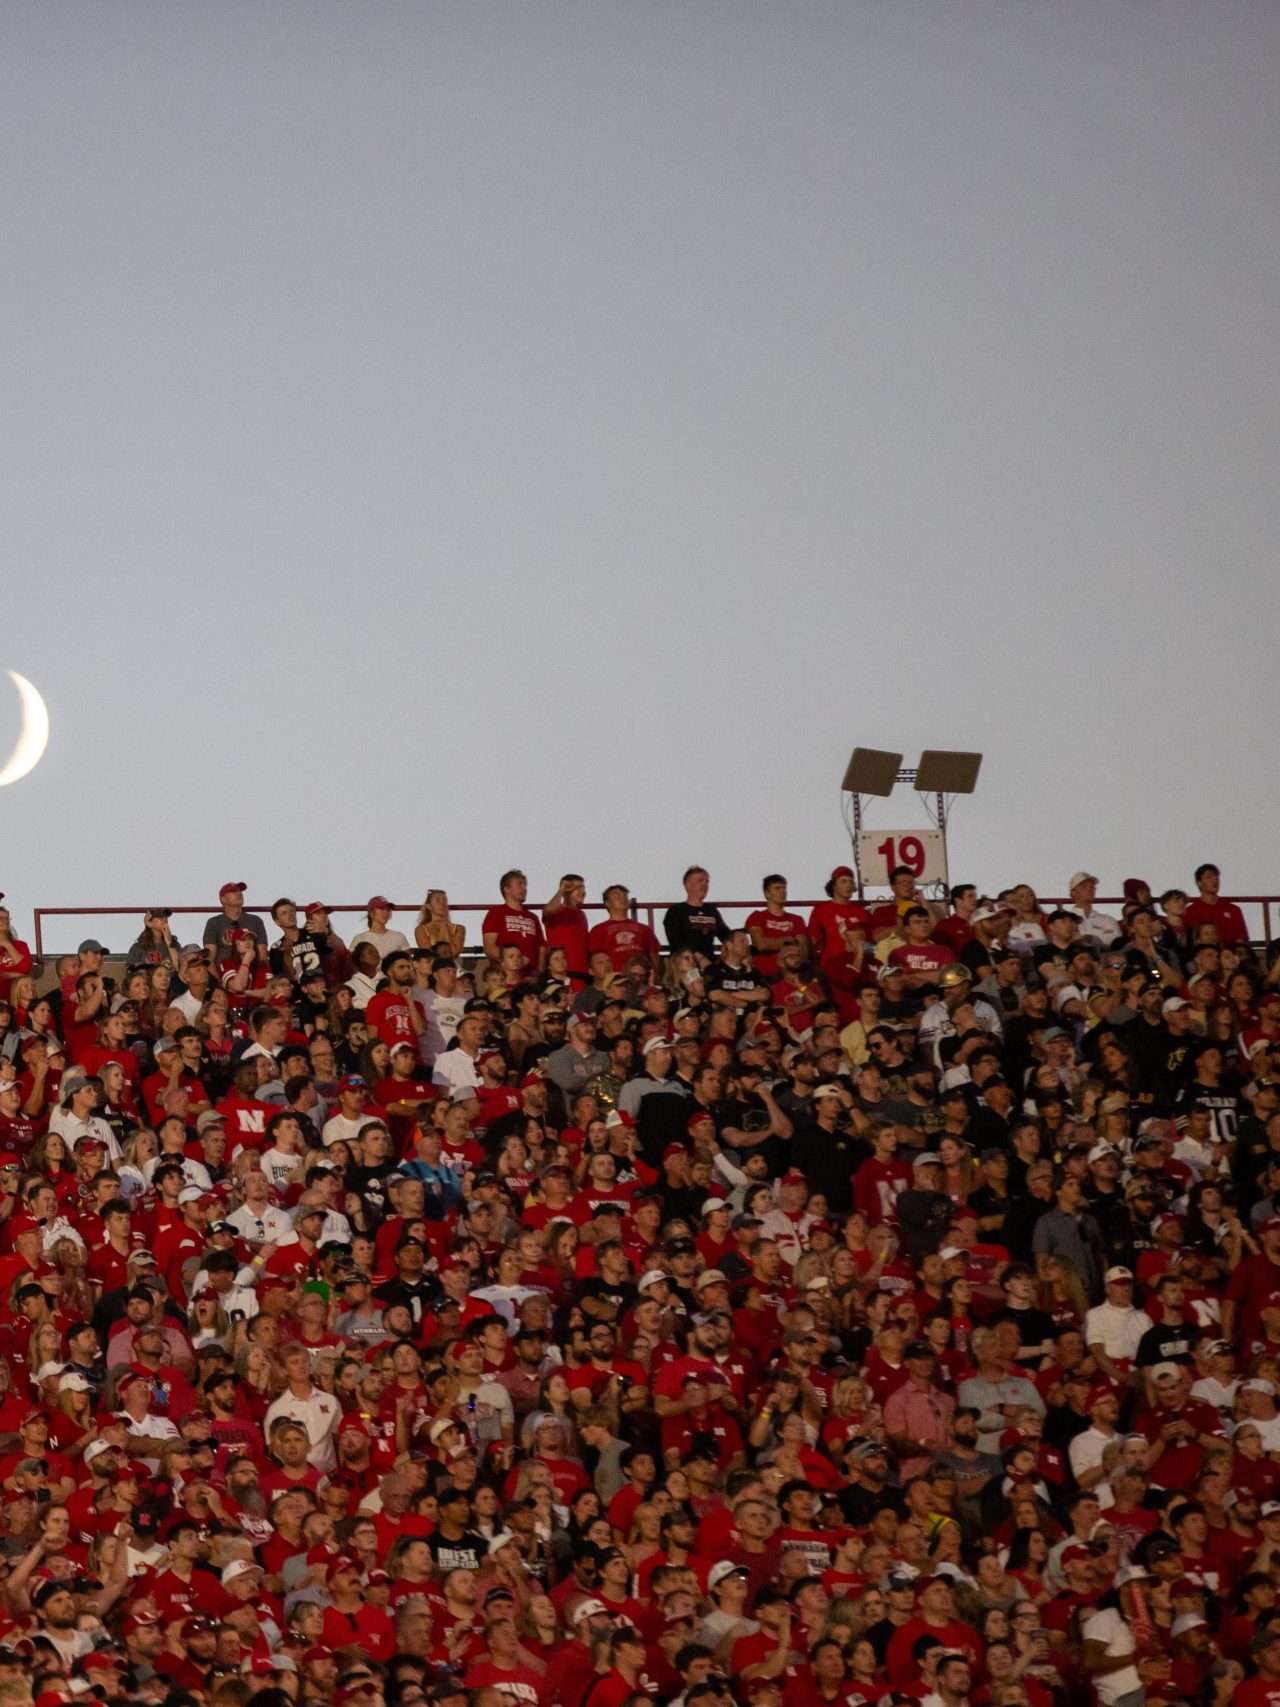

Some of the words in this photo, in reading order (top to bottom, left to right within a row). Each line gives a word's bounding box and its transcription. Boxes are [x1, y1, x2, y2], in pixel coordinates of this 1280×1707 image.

[878, 836, 926, 880] 19
[506, 1094, 519, 1106] N
[236, 1109, 265, 1133] N
[1208, 1108, 1238, 1143] 10
[319, 1404, 330, 1414] N
[49, 1436, 59, 1451] N
[436, 1547, 477, 1561] WEST
